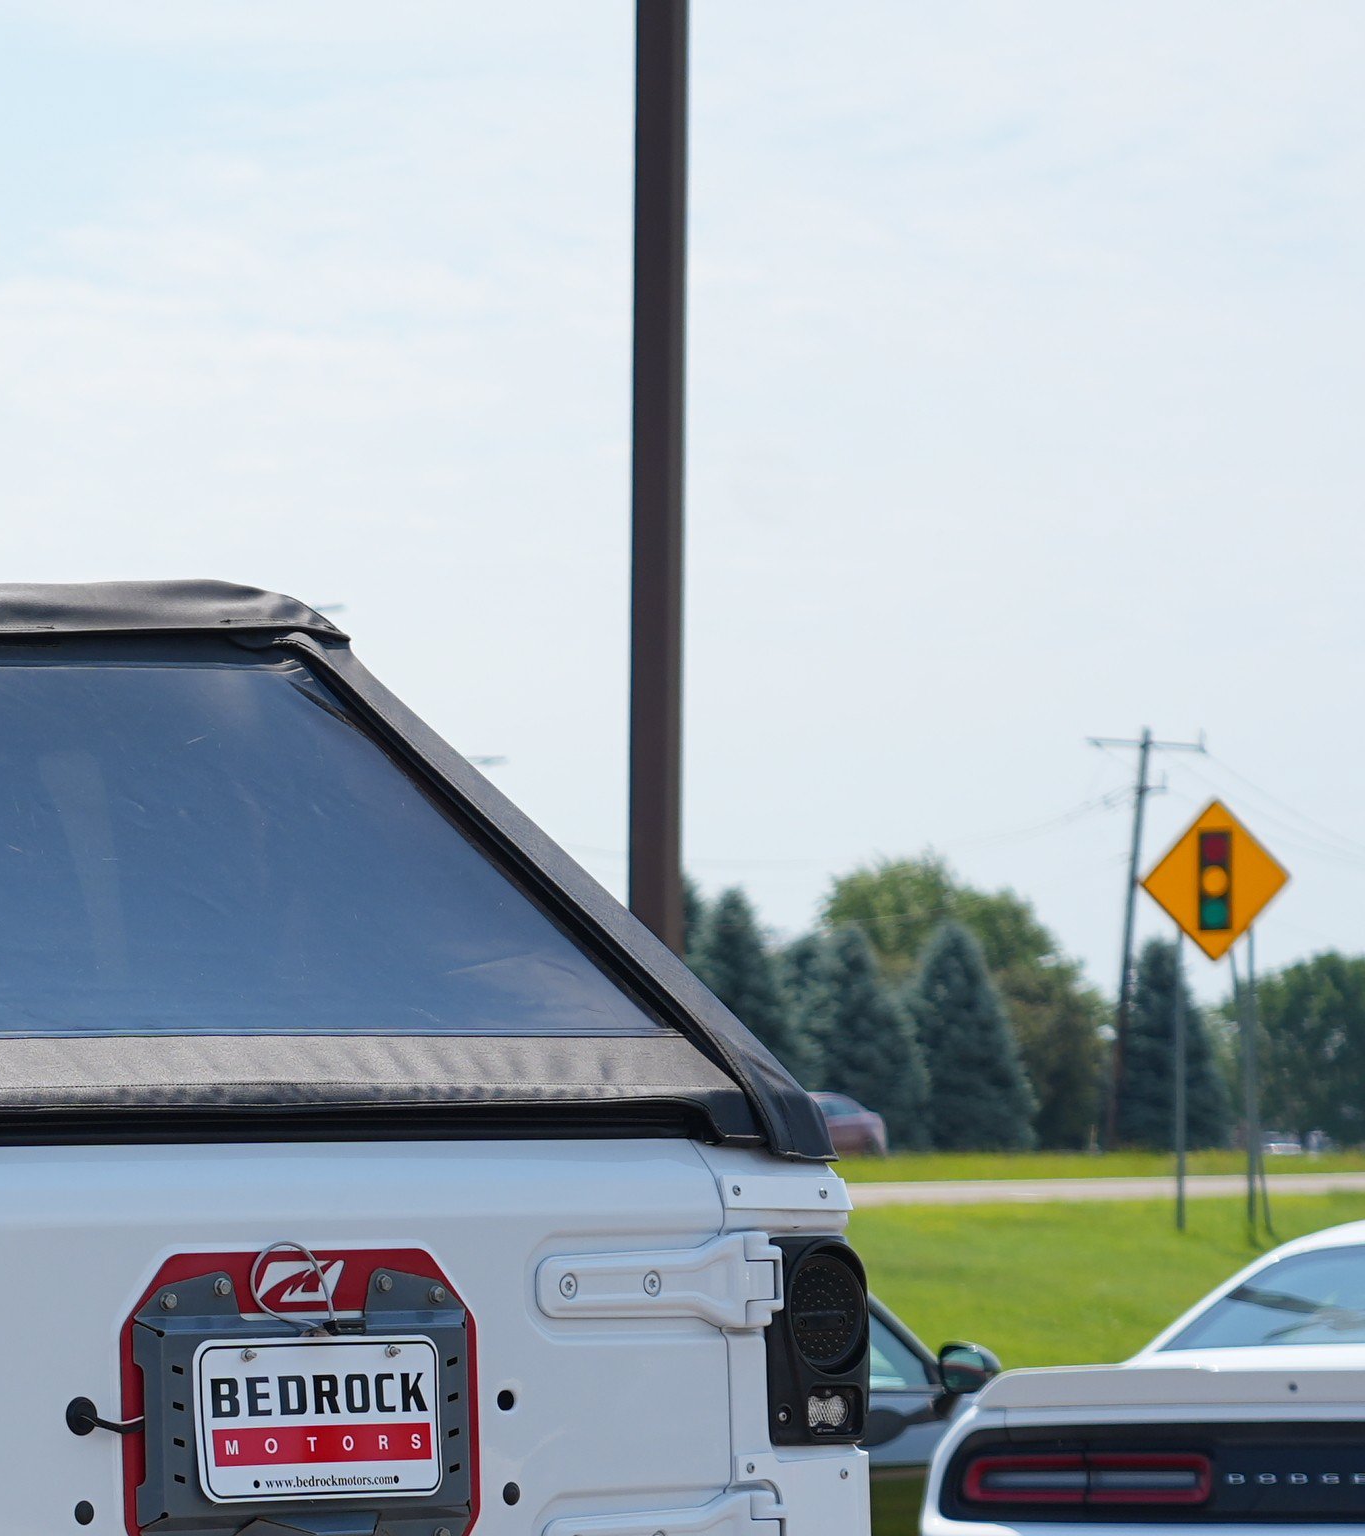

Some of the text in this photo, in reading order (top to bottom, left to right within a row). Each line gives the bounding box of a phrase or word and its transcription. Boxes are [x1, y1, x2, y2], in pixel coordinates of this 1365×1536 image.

[210, 1372, 428, 1418] BEDROCK
[224, 1433, 422, 1456] MOTORS
[265, 1474, 394, 1489] www.bedrockmotors.com
